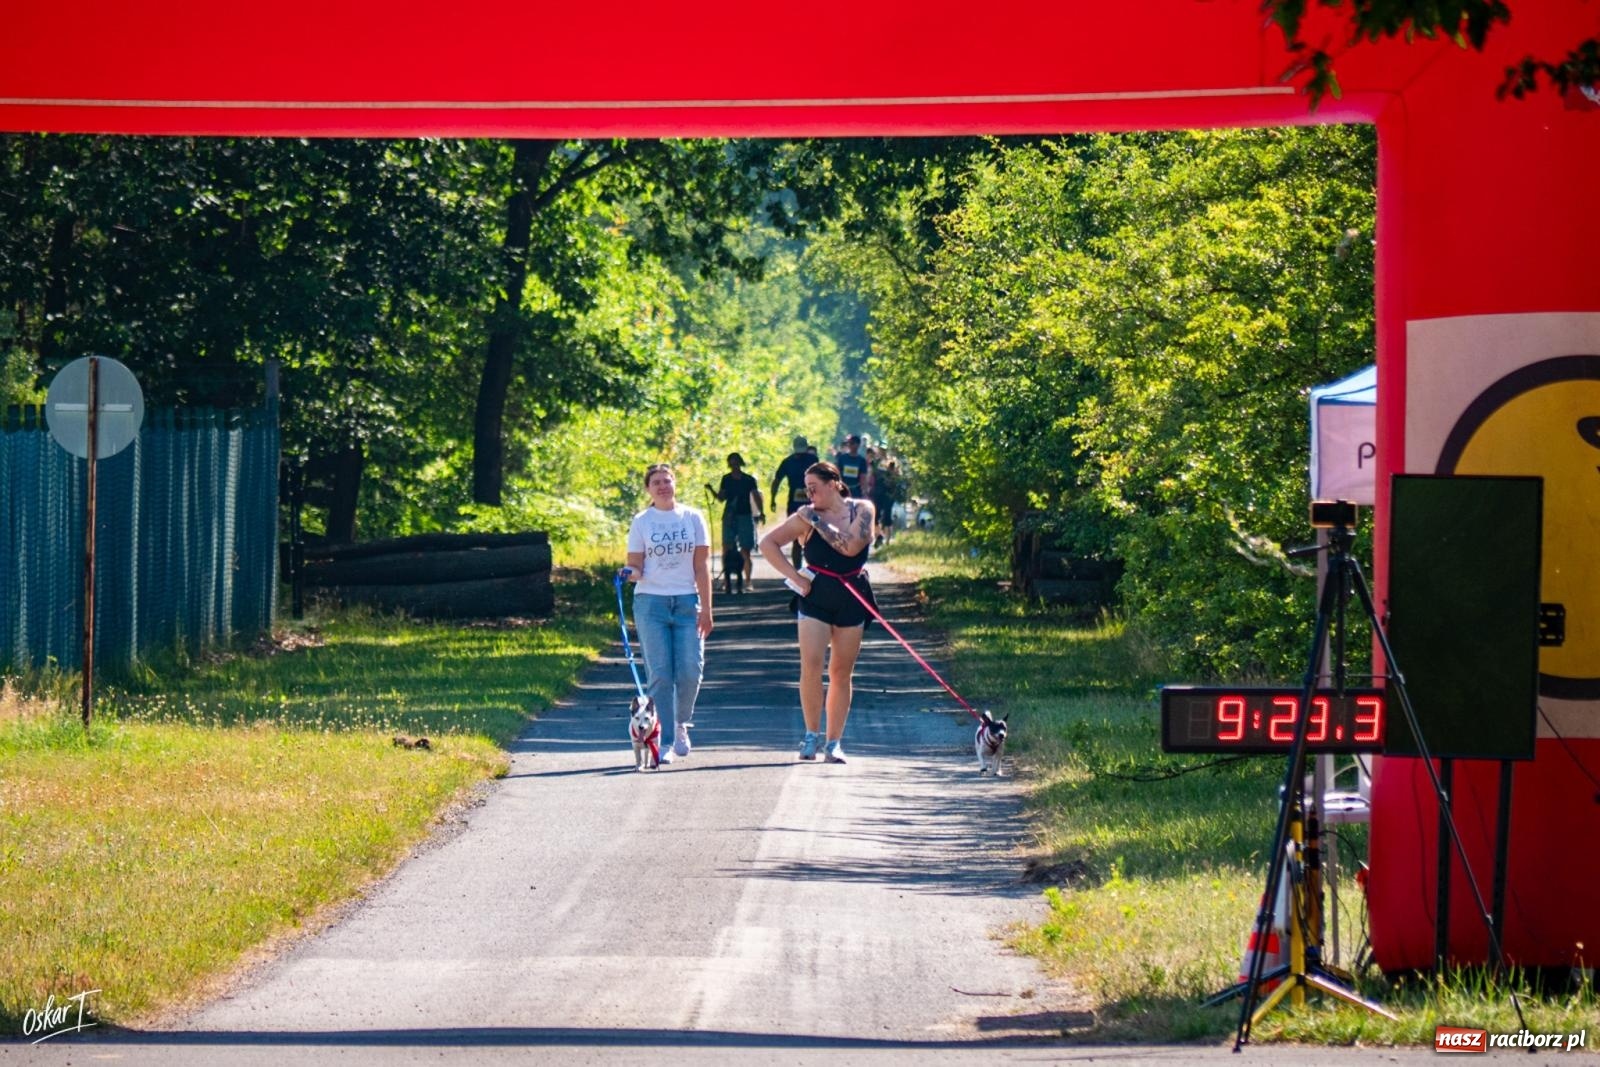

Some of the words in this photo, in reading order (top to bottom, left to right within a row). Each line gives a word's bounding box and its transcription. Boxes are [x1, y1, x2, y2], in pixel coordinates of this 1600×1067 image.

[650, 527, 689, 543] CAFÉ
[647, 542, 694, 558] POÉSIE
[1217, 697, 1382, 741] 9:23.3
